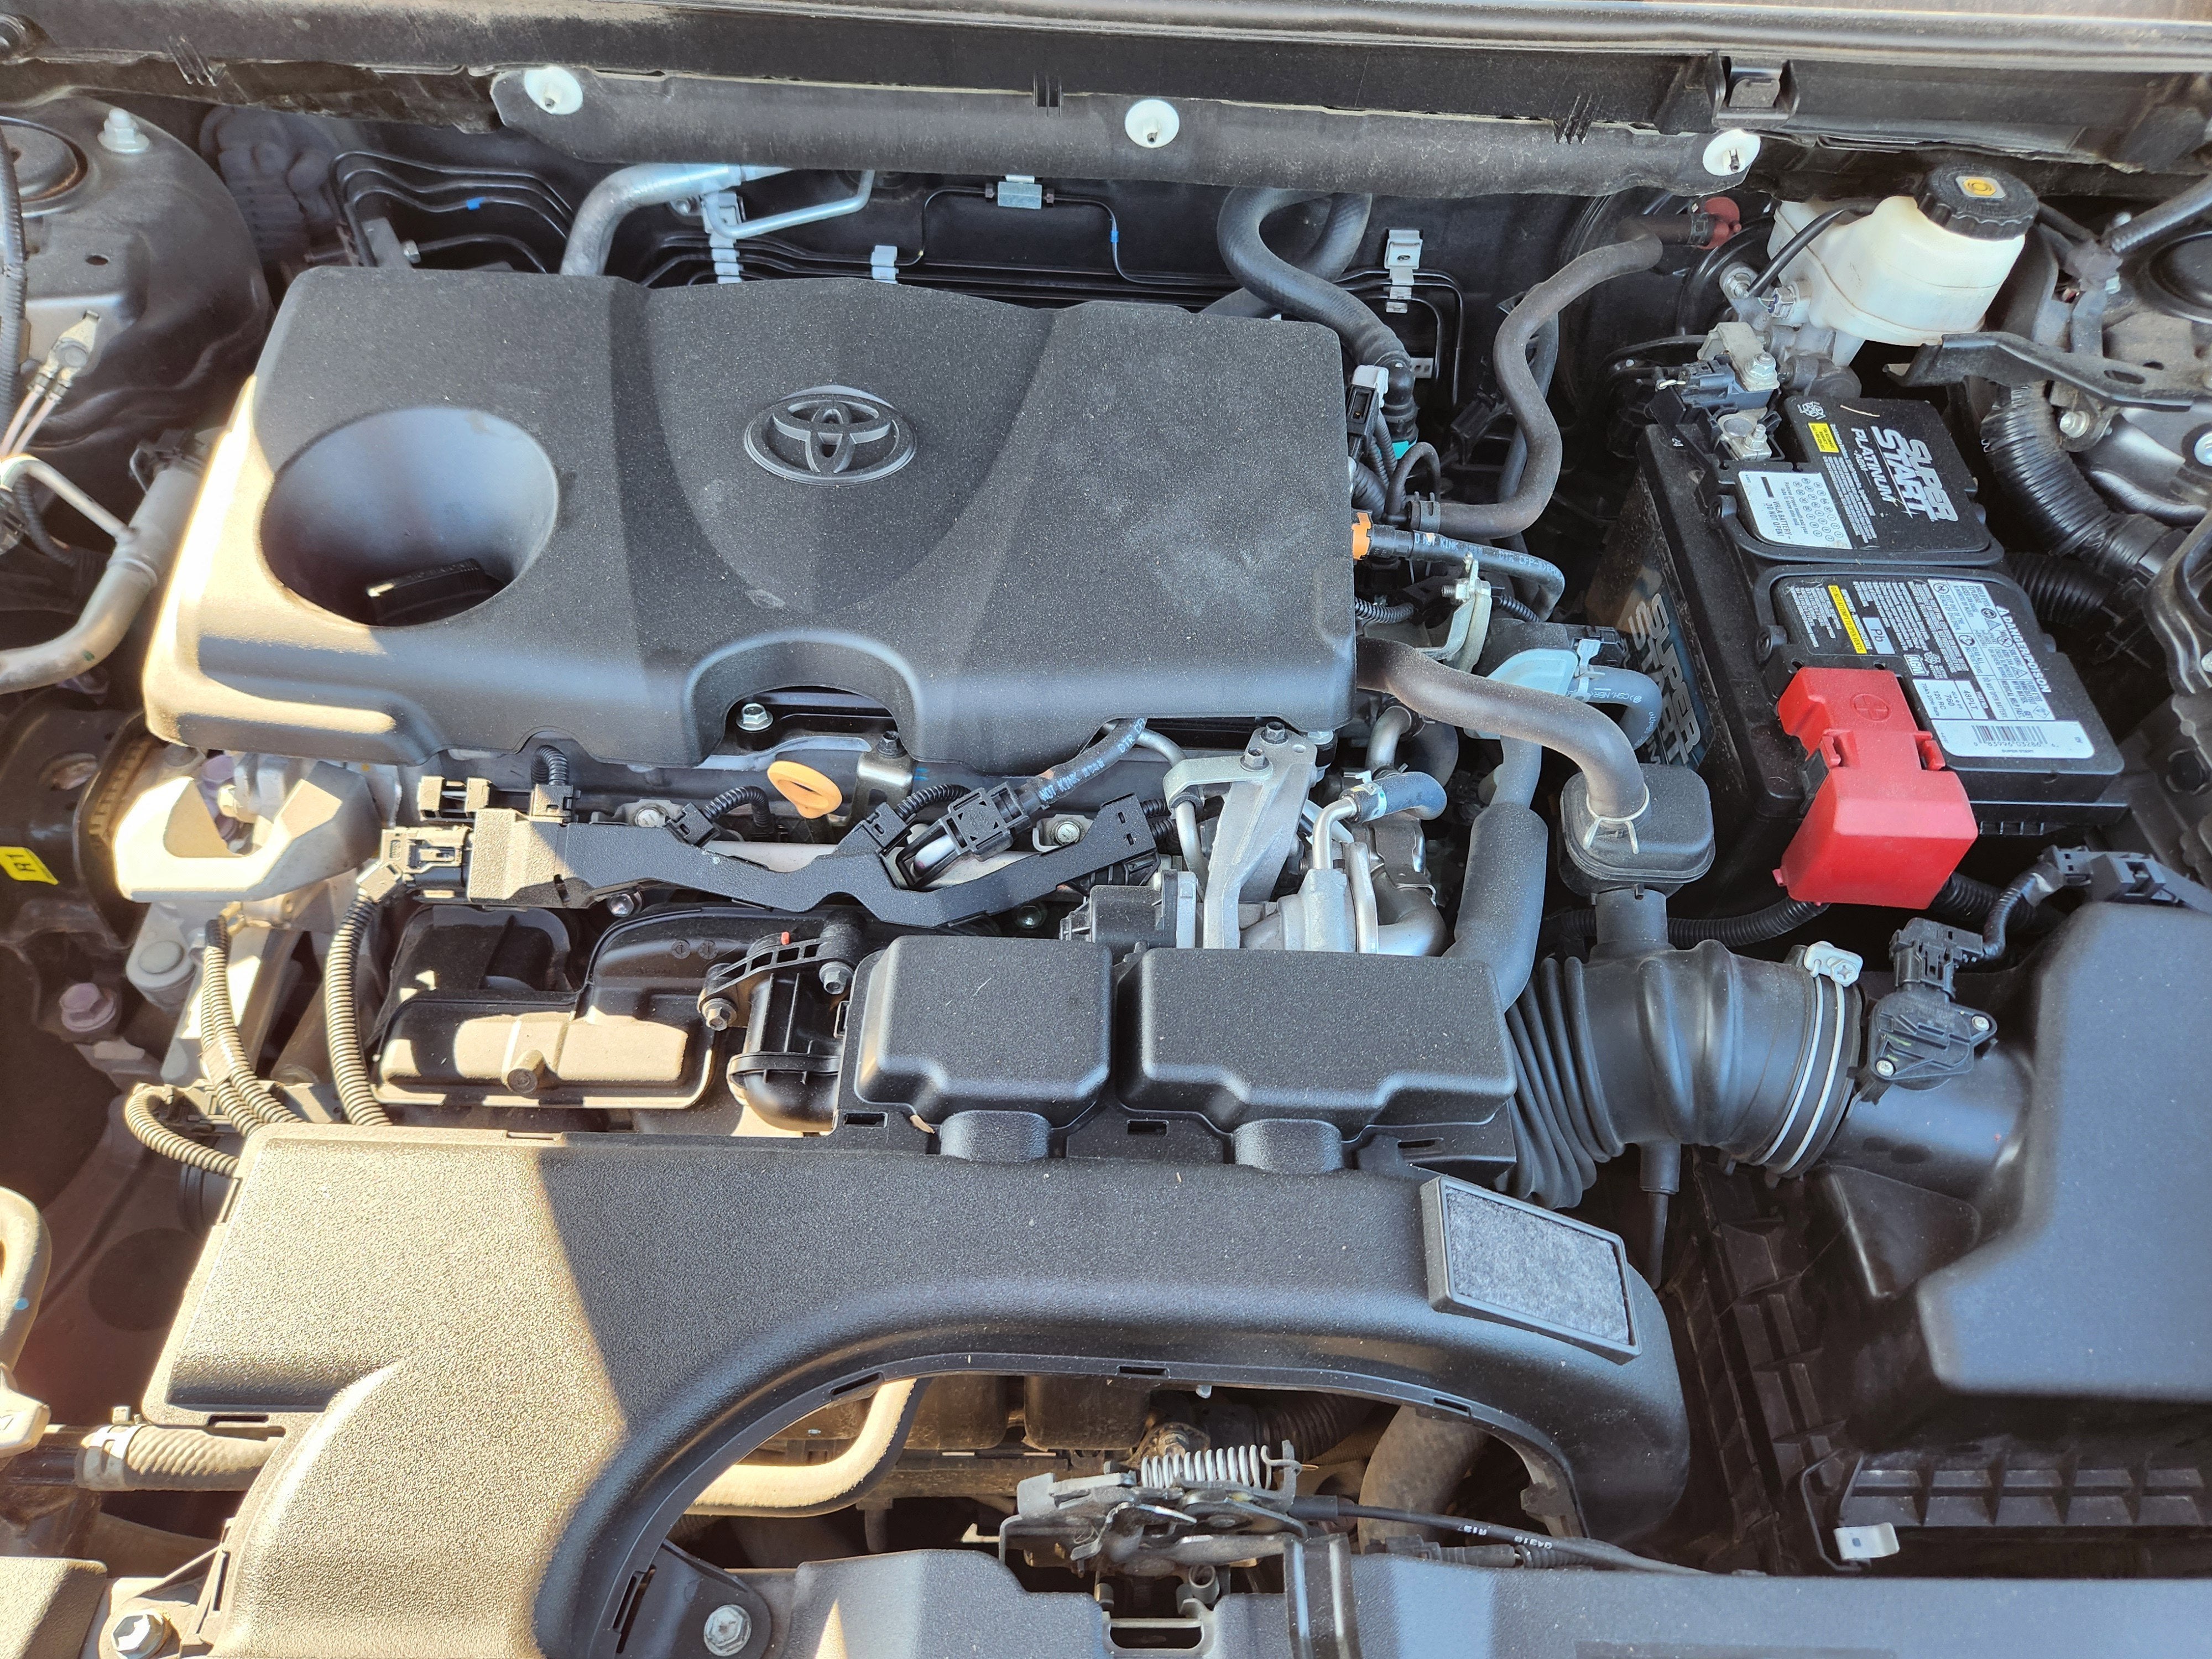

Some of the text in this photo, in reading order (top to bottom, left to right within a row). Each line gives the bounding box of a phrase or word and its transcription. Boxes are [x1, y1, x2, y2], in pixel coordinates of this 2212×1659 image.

[1851, 427, 1895, 503] PLATINUM
[1871, 426, 1936, 522] START
[1908, 439, 1958, 521] SUPER
[1768, 511, 1778, 521] NOT
[1772, 501, 1791, 535] VRLA BATTERY
[1772, 521, 1784, 536] OPEN!
[1439, 536, 1458, 550] KINK
[1837, 601, 1852, 619] ATTEMPT
[1847, 626, 1859, 637] OPEN
[1870, 628, 1887, 643] Pb
[2001, 615, 2052, 692] DANGER/POISON
[1651, 593, 1700, 753] SUPER
[1908, 656, 1926, 675] AGM
[2000, 680, 2015, 696] MEDICAL
[2008, 697, 2020, 707] HELP
[2011, 681, 2021, 690] WITH
[2018, 681, 2036, 704] IMMEDIATELY
[2025, 681, 2043, 701] FLUSH EYES
[1921, 683, 1931, 693] 70Ah
[1932, 706, 1940, 716] Rate
[1932, 691, 1947, 709] 120 RC
[1943, 695, 1955, 706] 760
[1989, 691, 2000, 701] OPEN
[1118, 733, 1135, 753] DTR
